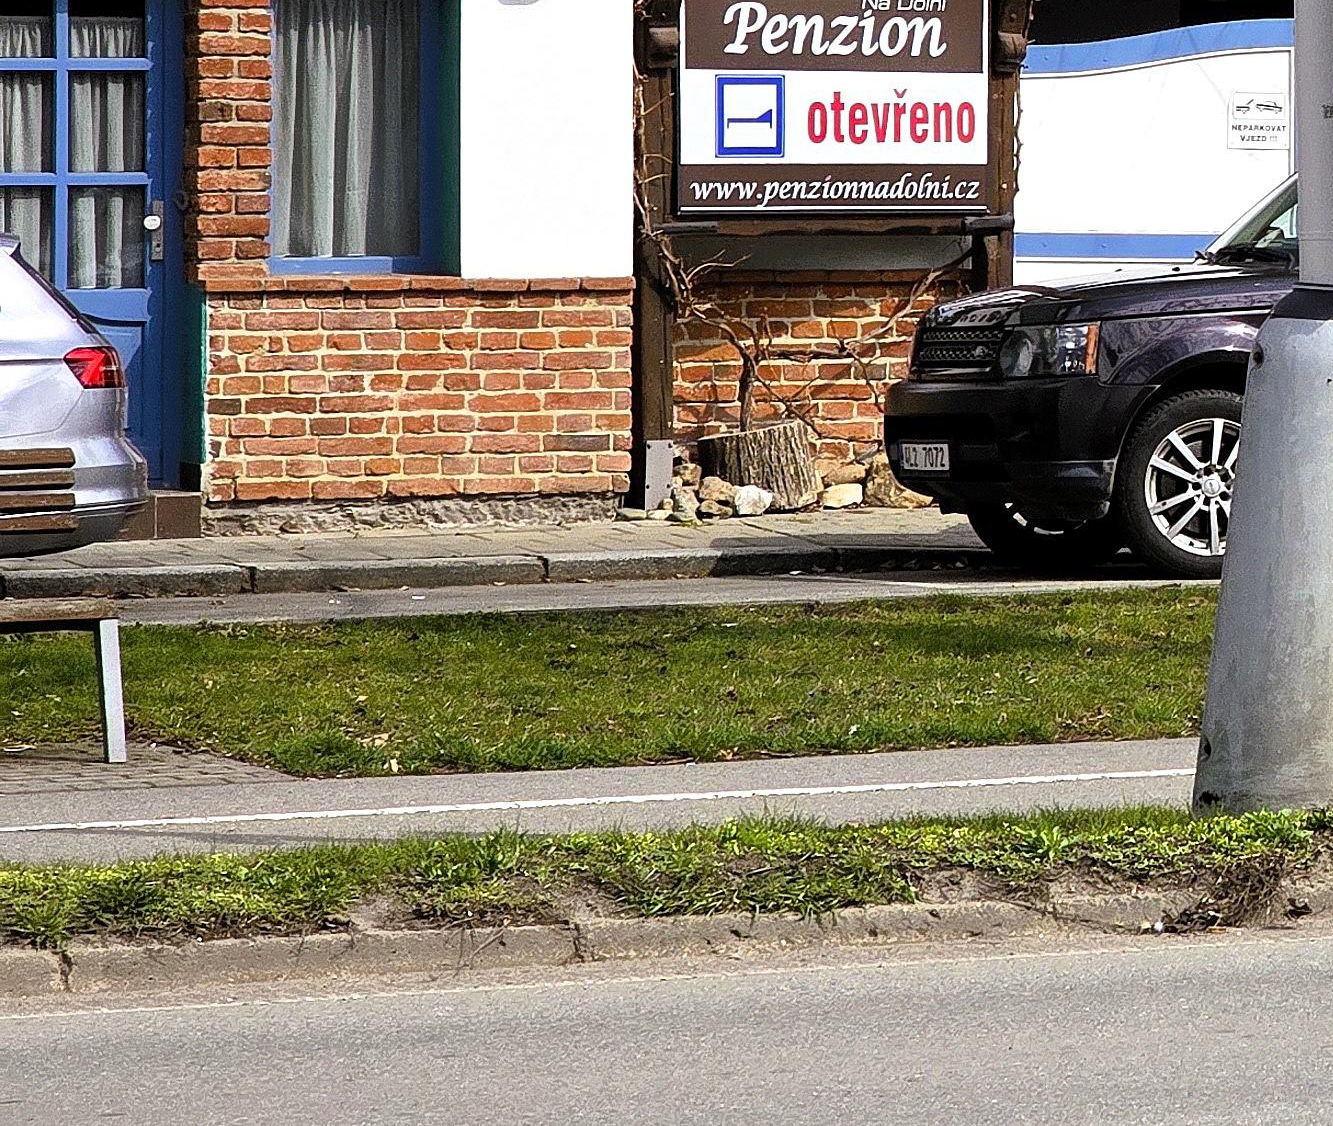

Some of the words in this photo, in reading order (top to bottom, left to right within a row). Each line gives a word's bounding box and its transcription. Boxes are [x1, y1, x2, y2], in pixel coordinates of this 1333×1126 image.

[723, 1, 947, 58] Penzion
[807, 88, 976, 145] otevřeno
[1231, 124, 1287, 132] NEPARKOVAT
[1239, 134, 1267, 142] VJEZD
[689, 172, 981, 208] www.penzionnadolni.cz
